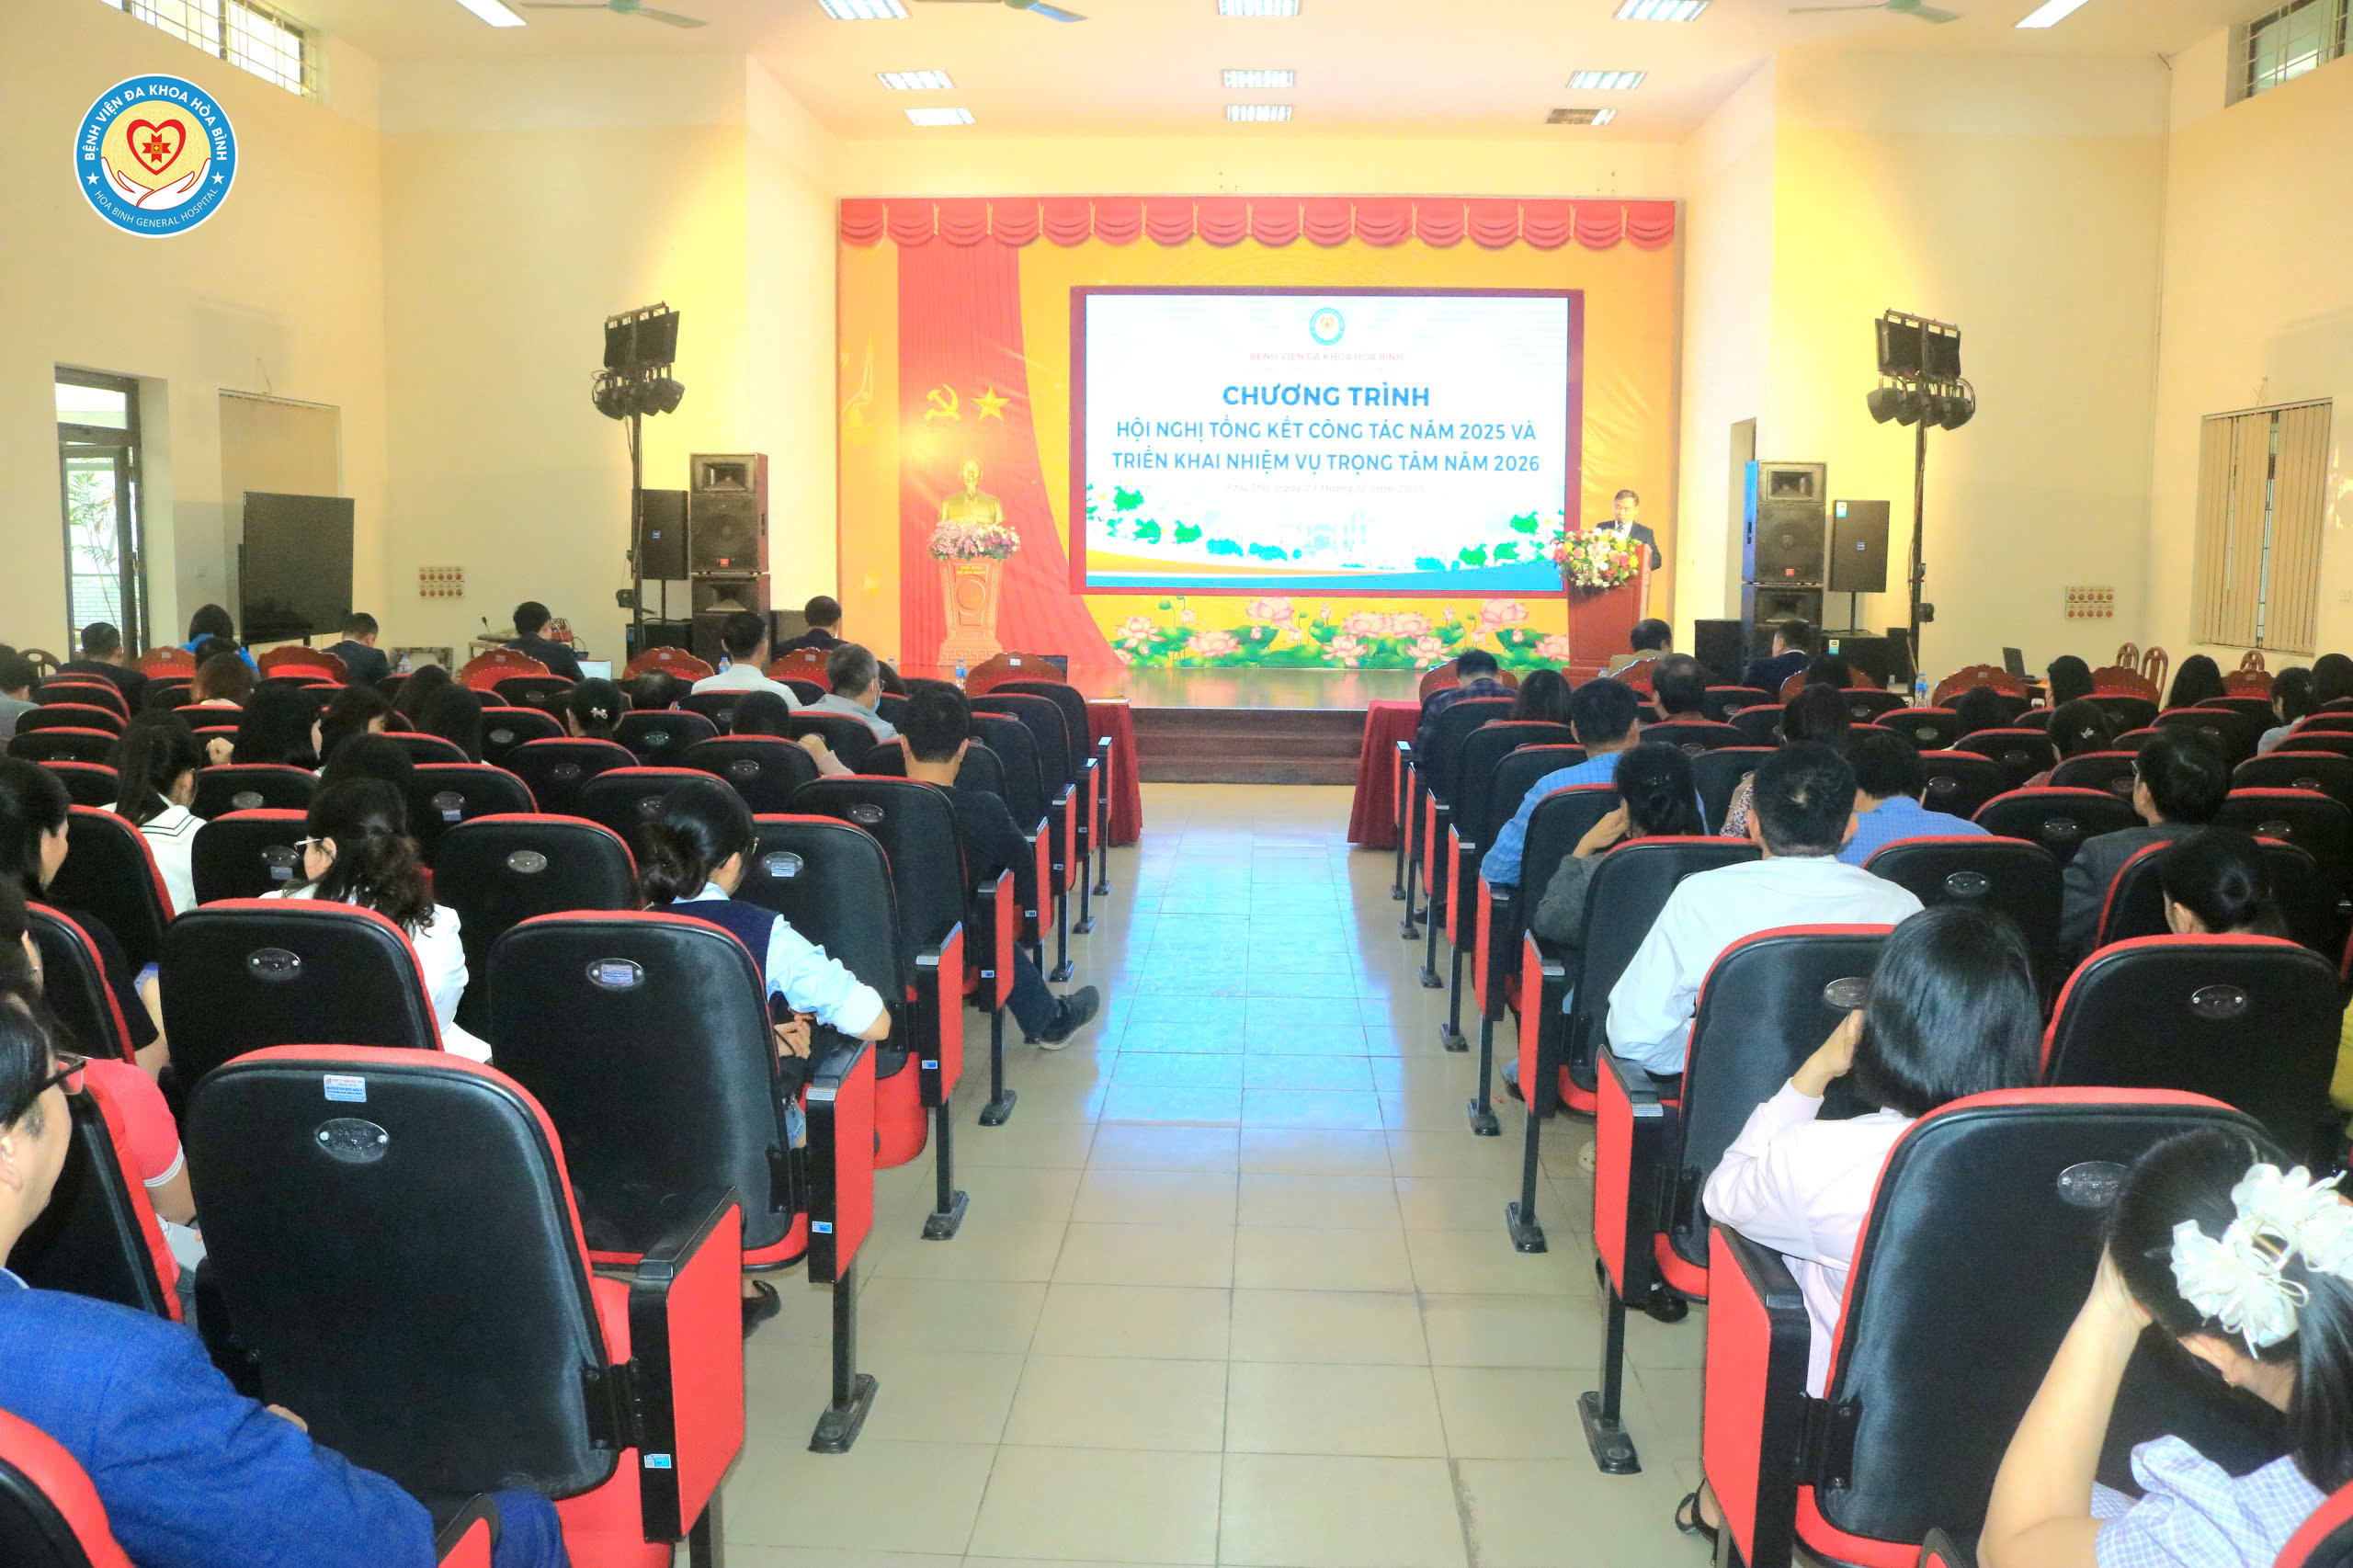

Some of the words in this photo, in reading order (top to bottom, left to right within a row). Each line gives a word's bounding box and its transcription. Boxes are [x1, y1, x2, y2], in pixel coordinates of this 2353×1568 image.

[1222, 382, 1341, 406] CHƯƠNG
[1347, 381, 1430, 407] TRÌNH
[1117, 416, 1151, 442] HỘI
[1156, 421, 1204, 443] NGHỊ
[1209, 414, 1262, 438] TỔNG
[1267, 415, 1304, 438] KẾT
[1308, 418, 1364, 439] CÔNG
[1369, 419, 1404, 439] TÁC
[1410, 419, 1455, 440] NĂM
[1460, 423, 1506, 440] 2025
[1511, 420, 1537, 440] VÀ
[1111, 445, 1168, 470] TRIỂN
[1175, 452, 1221, 470] KHAI
[1226, 449, 1290, 475] NHIỆM
[1295, 453, 1322, 475] VỤ
[1326, 454, 1393, 475] TRỌNG
[1398, 450, 1438, 471] TÂM
[1445, 451, 1489, 472] NĂM
[1494, 455, 1540, 472] 2026
